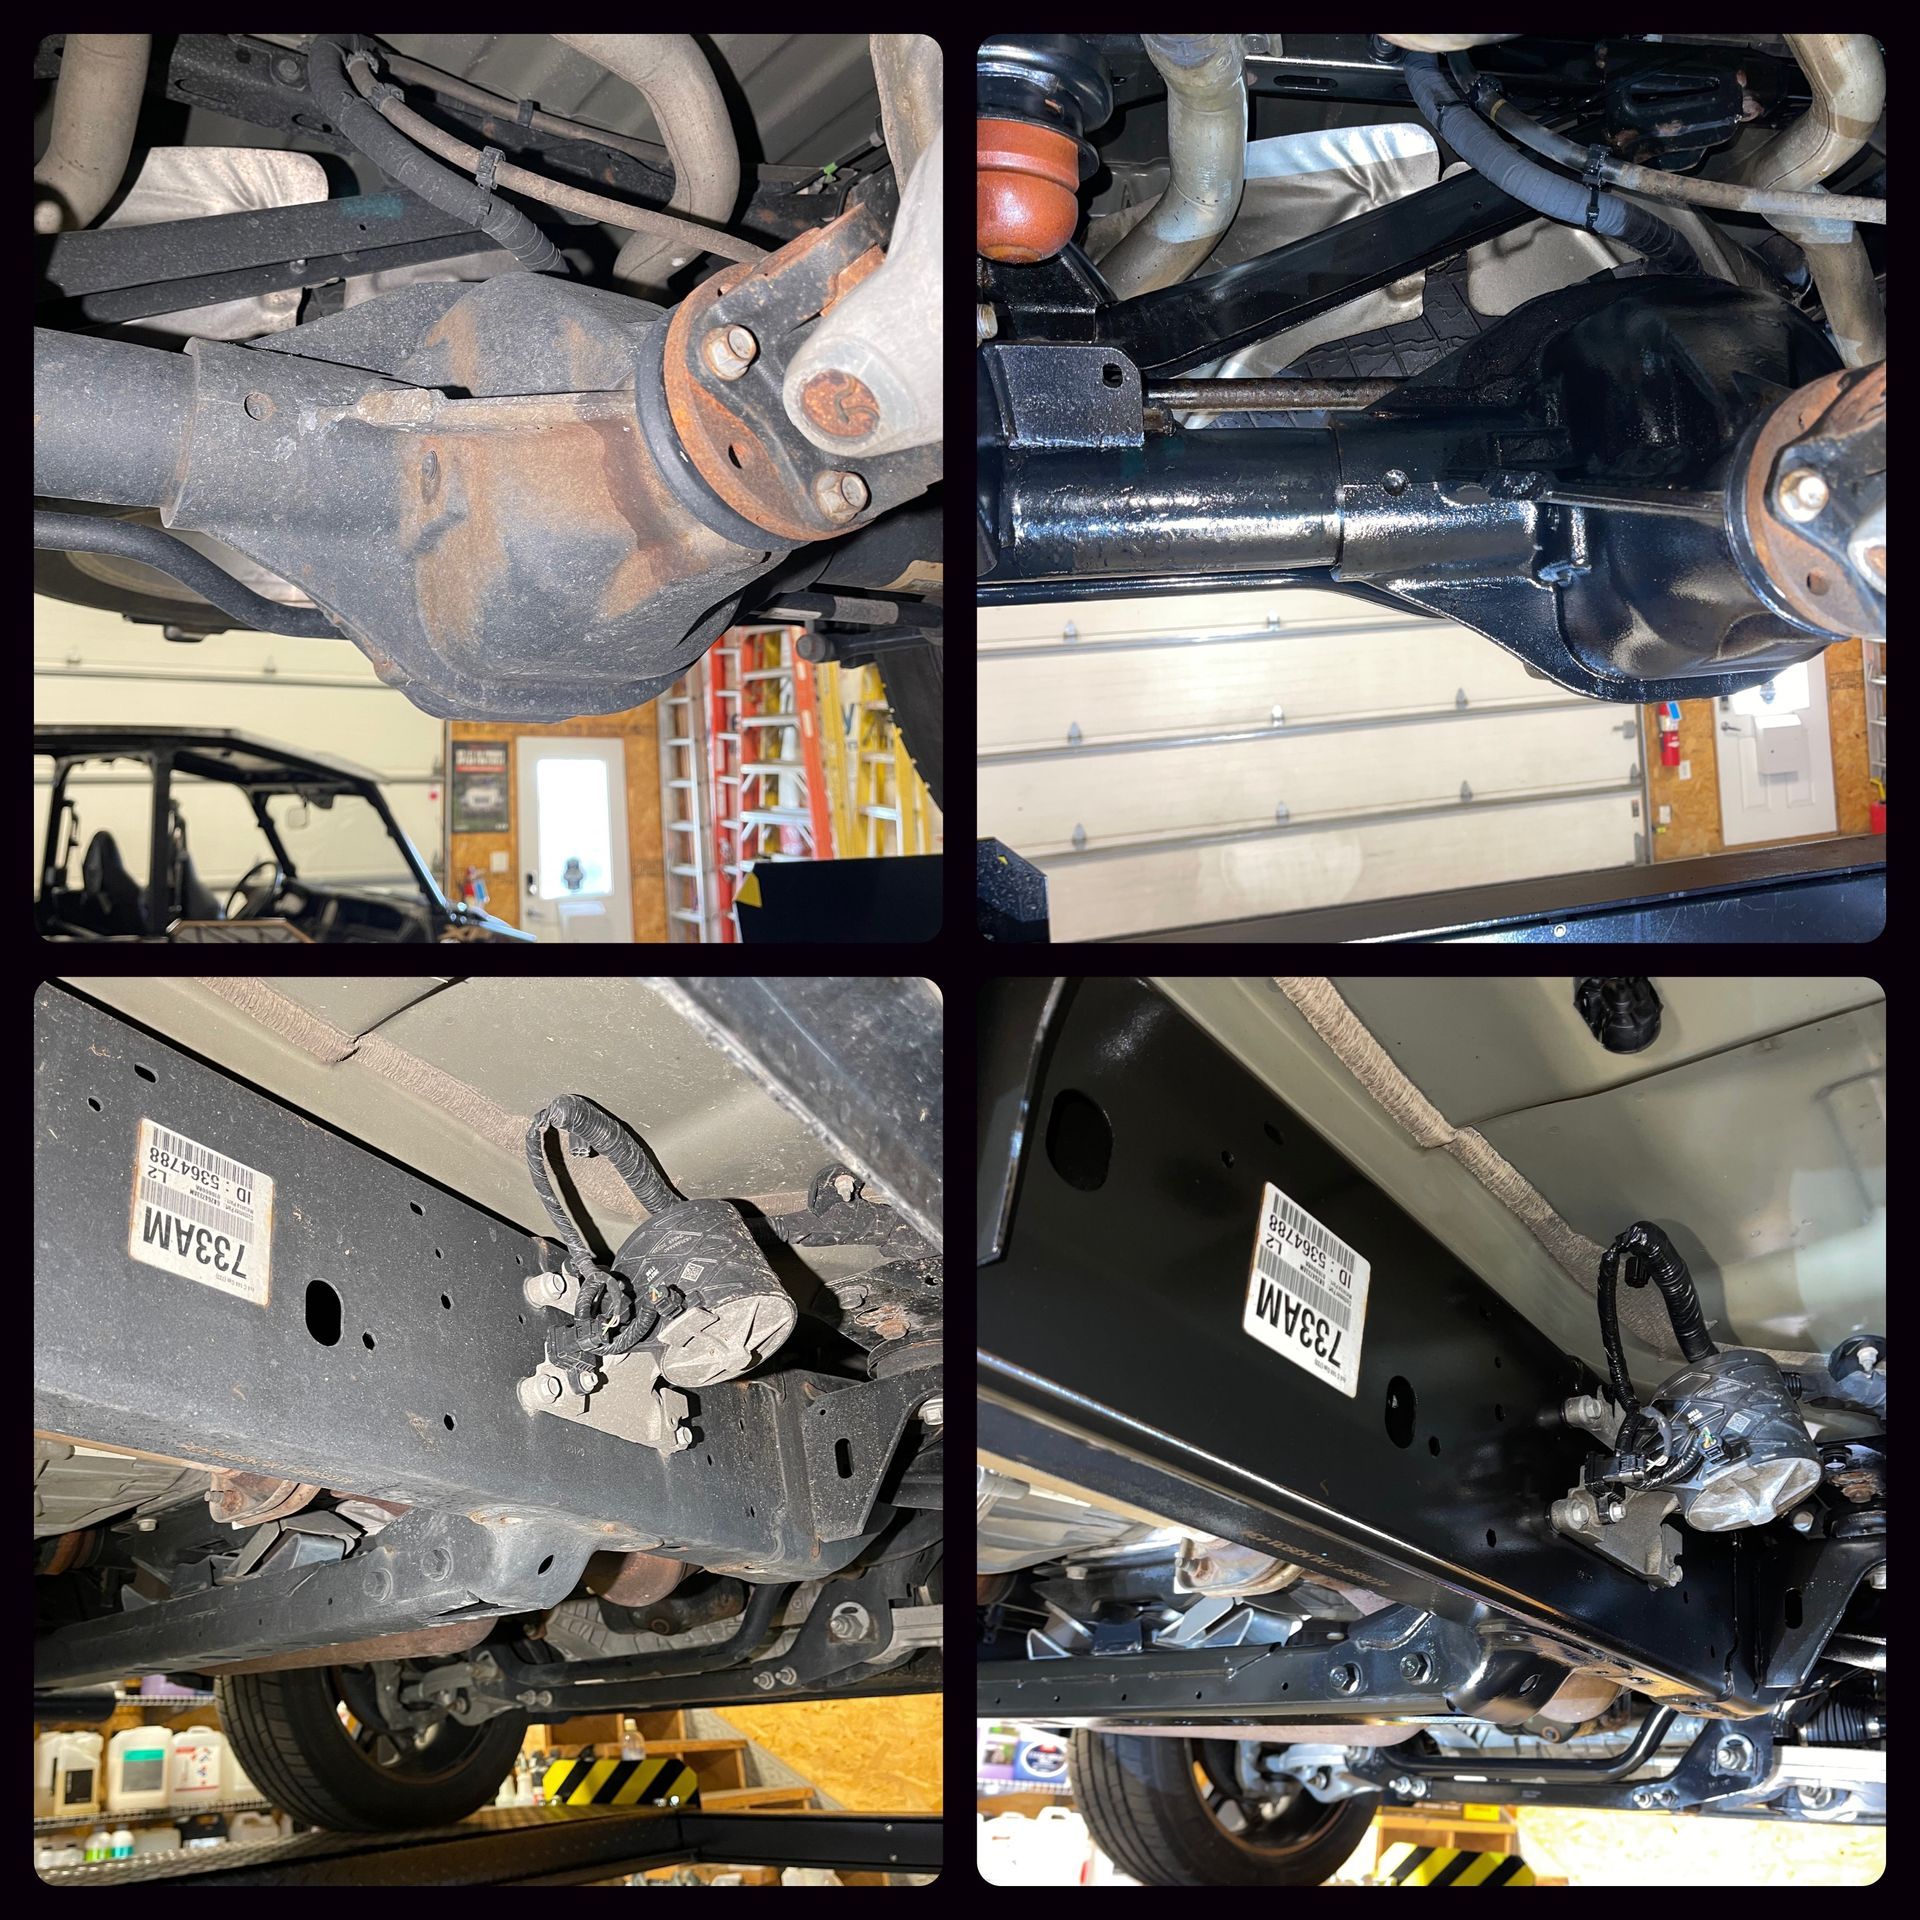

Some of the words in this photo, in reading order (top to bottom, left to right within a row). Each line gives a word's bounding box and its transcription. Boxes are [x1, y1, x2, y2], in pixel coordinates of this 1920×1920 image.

[148, 1165, 167, 1184] L2
[149, 1146, 220, 1190] 5364788
[236, 1186, 251, 1204] ID
[142, 1205, 247, 1279] 733AM
[1266, 1233, 1282, 1256] L2
[1268, 1213, 1327, 1269] 5364788
[1338, 1267, 1352, 1289] ID
[1255, 1277, 1343, 1368] 733AM
